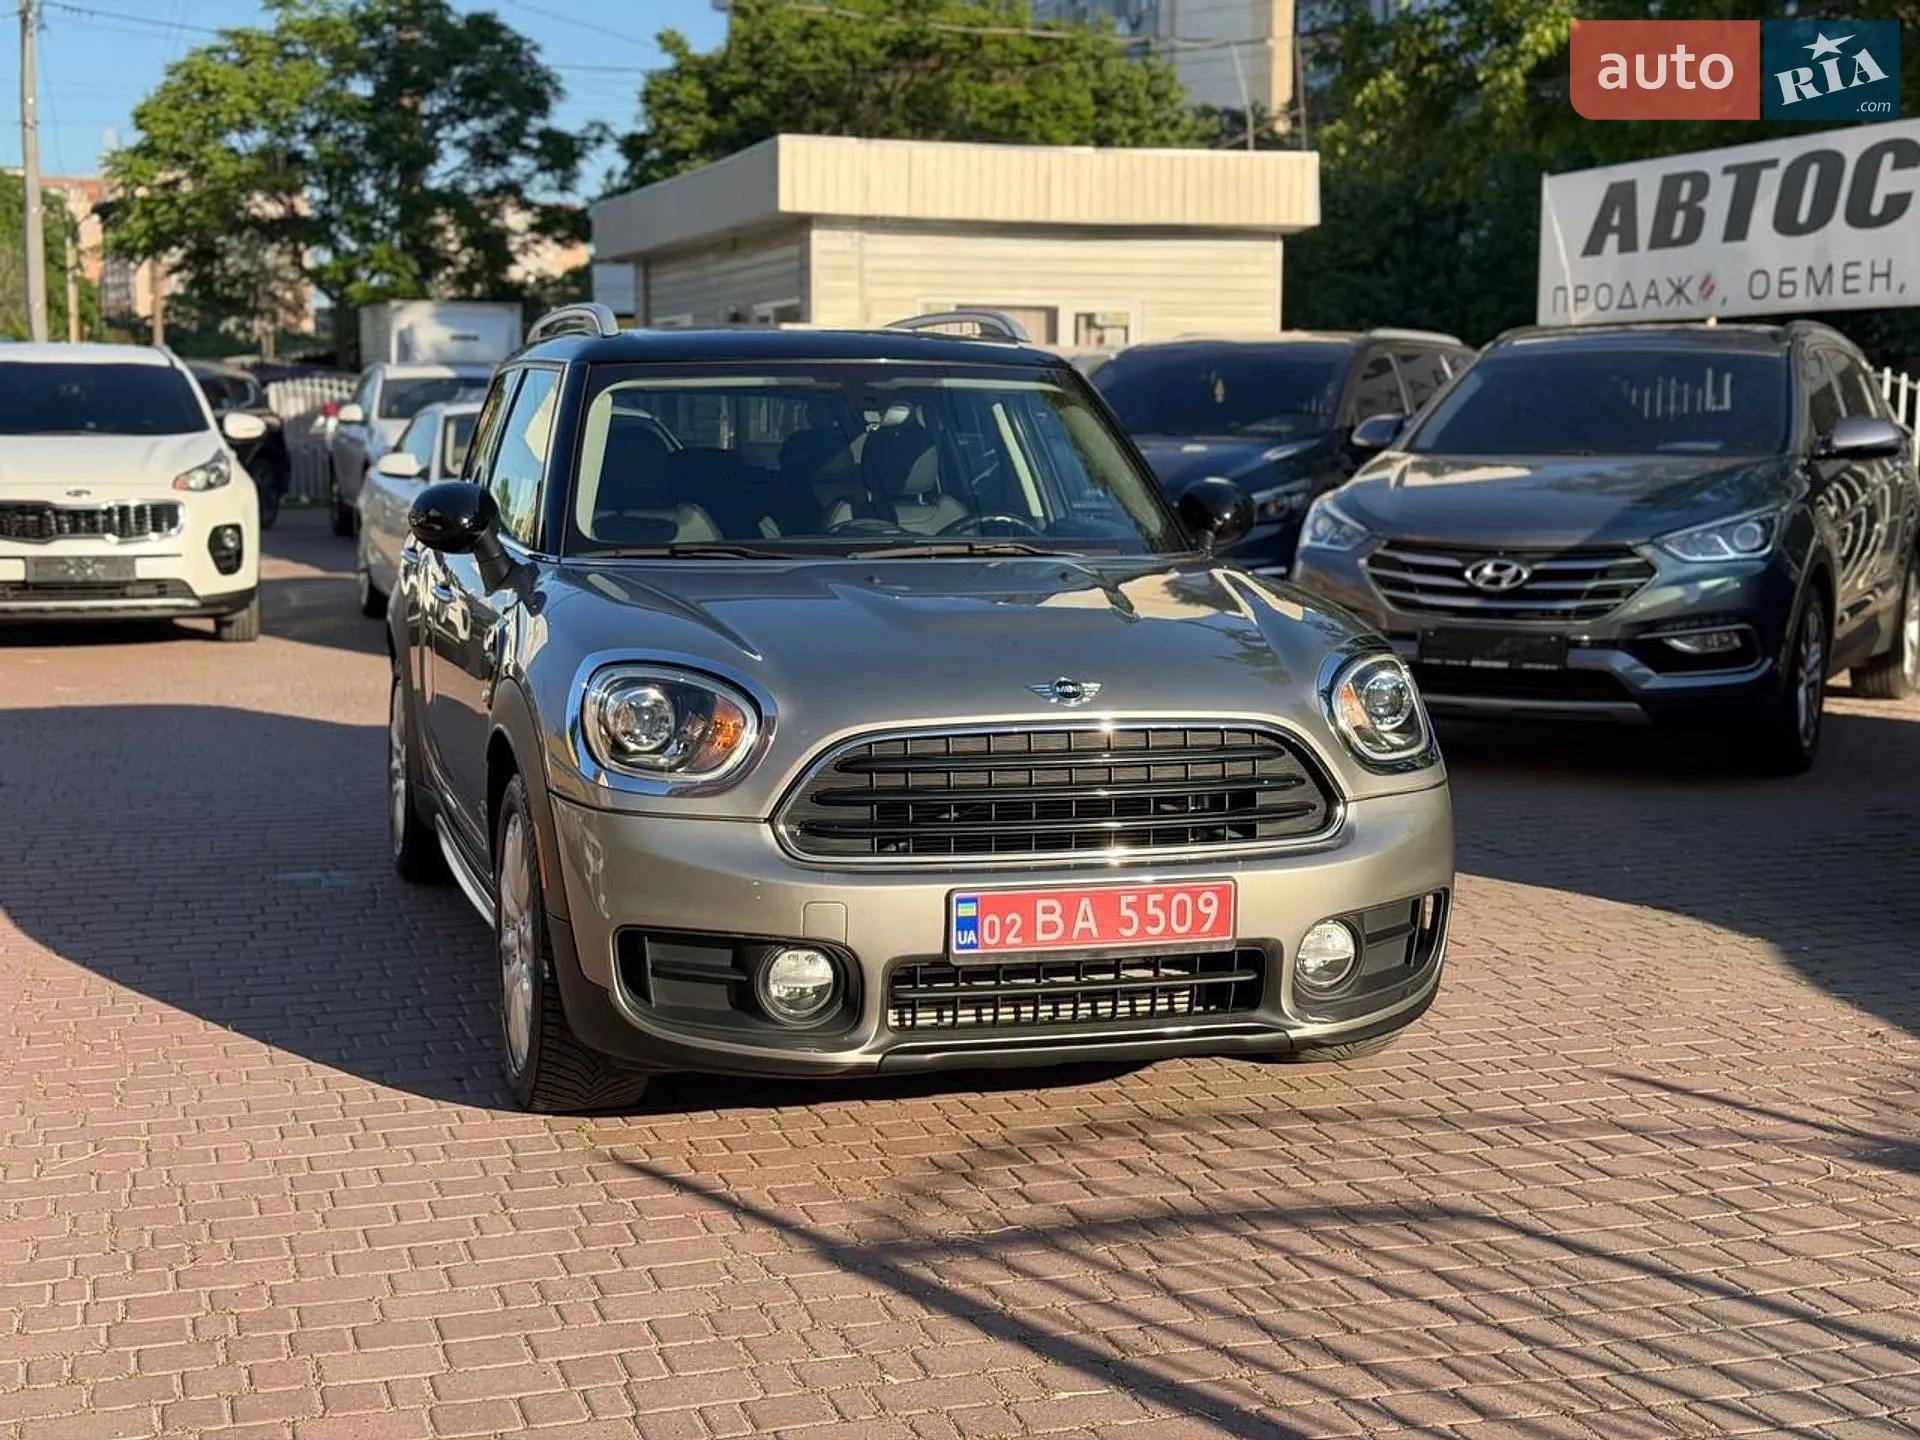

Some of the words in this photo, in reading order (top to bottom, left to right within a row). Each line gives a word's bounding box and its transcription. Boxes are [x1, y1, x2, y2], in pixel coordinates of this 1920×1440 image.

[1748, 258, 1906, 301] ОБМЕН,
[957, 929, 977, 945] UA
[982, 911, 1023, 945] 02
[1035, 896, 1099, 942] BA
[1117, 890, 1219, 938] 5509
